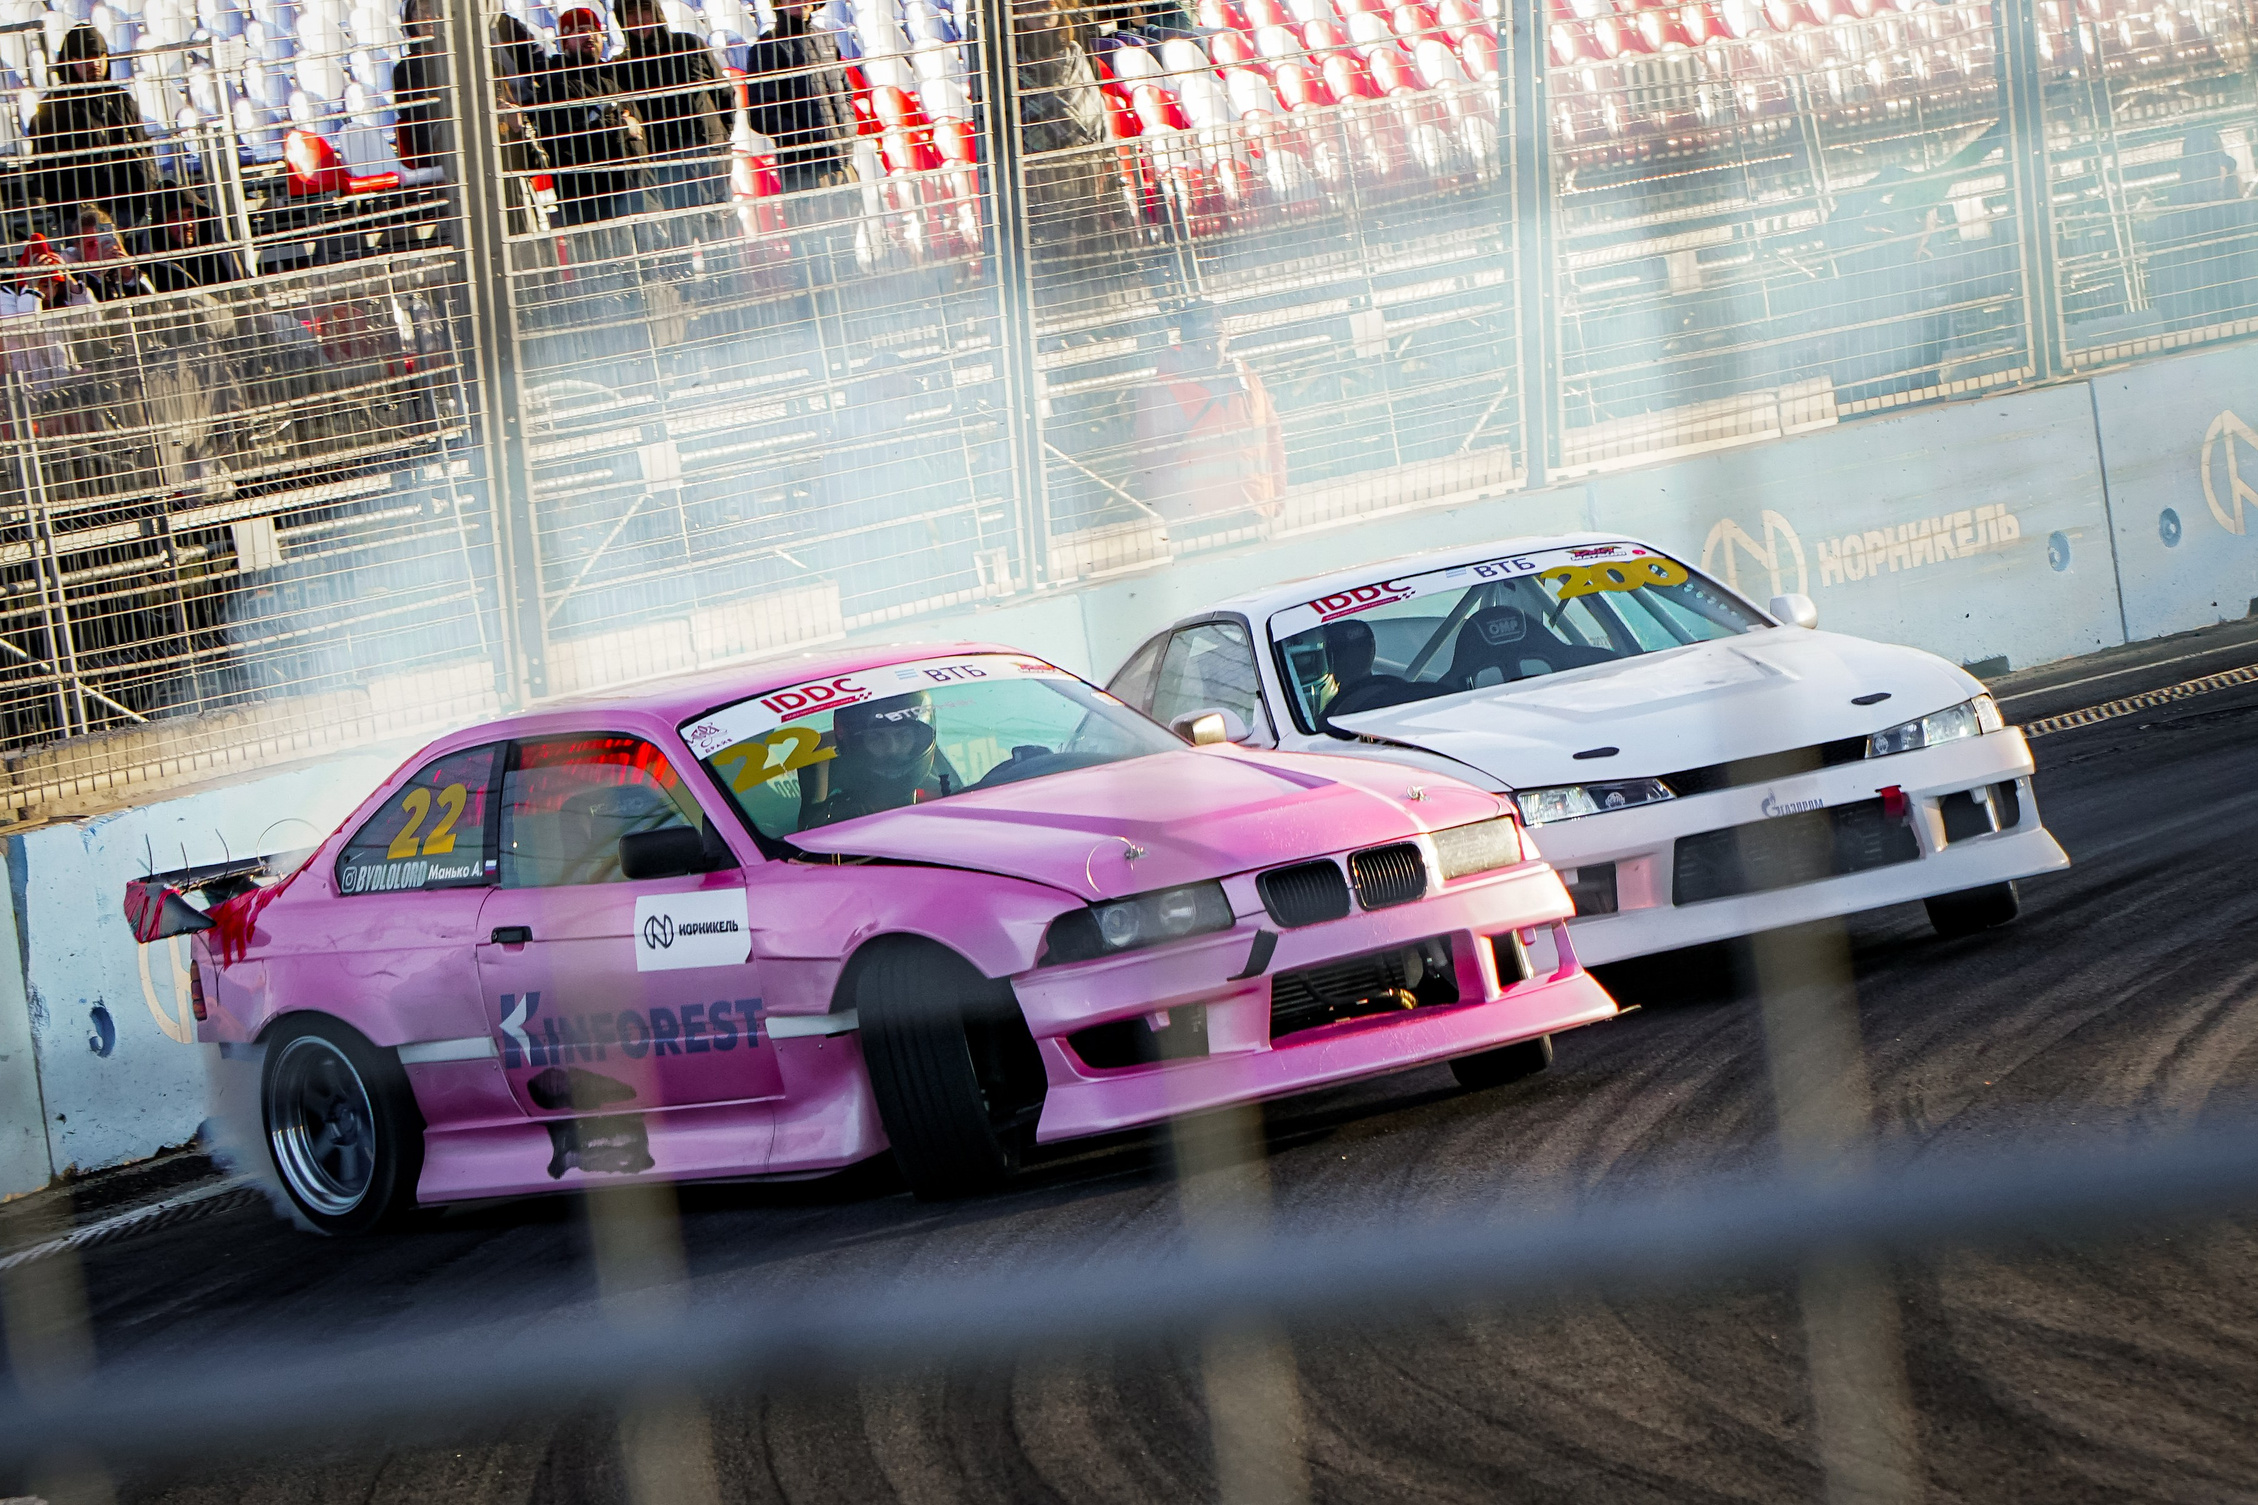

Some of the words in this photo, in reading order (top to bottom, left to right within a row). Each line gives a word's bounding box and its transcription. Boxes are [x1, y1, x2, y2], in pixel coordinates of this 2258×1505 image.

[1817, 503, 2022, 587] НОРНИКЕЛЬ
[1473, 557, 1536, 578] ВТБ
[1540, 557, 1688, 600] 200
[1308, 579, 1412, 614] IDDC
[922, 665, 987, 682] ВТБ
[760, 678, 867, 714] IDDC
[713, 727, 838, 794] 22
[386, 783, 467, 860] 22
[355, 860, 428, 892] BYDLOLORD
[428, 864, 469, 880] Манько
[678, 920, 739, 936] НОРНИКЕЛЬ
[499, 991, 763, 1069] KINFOREST
